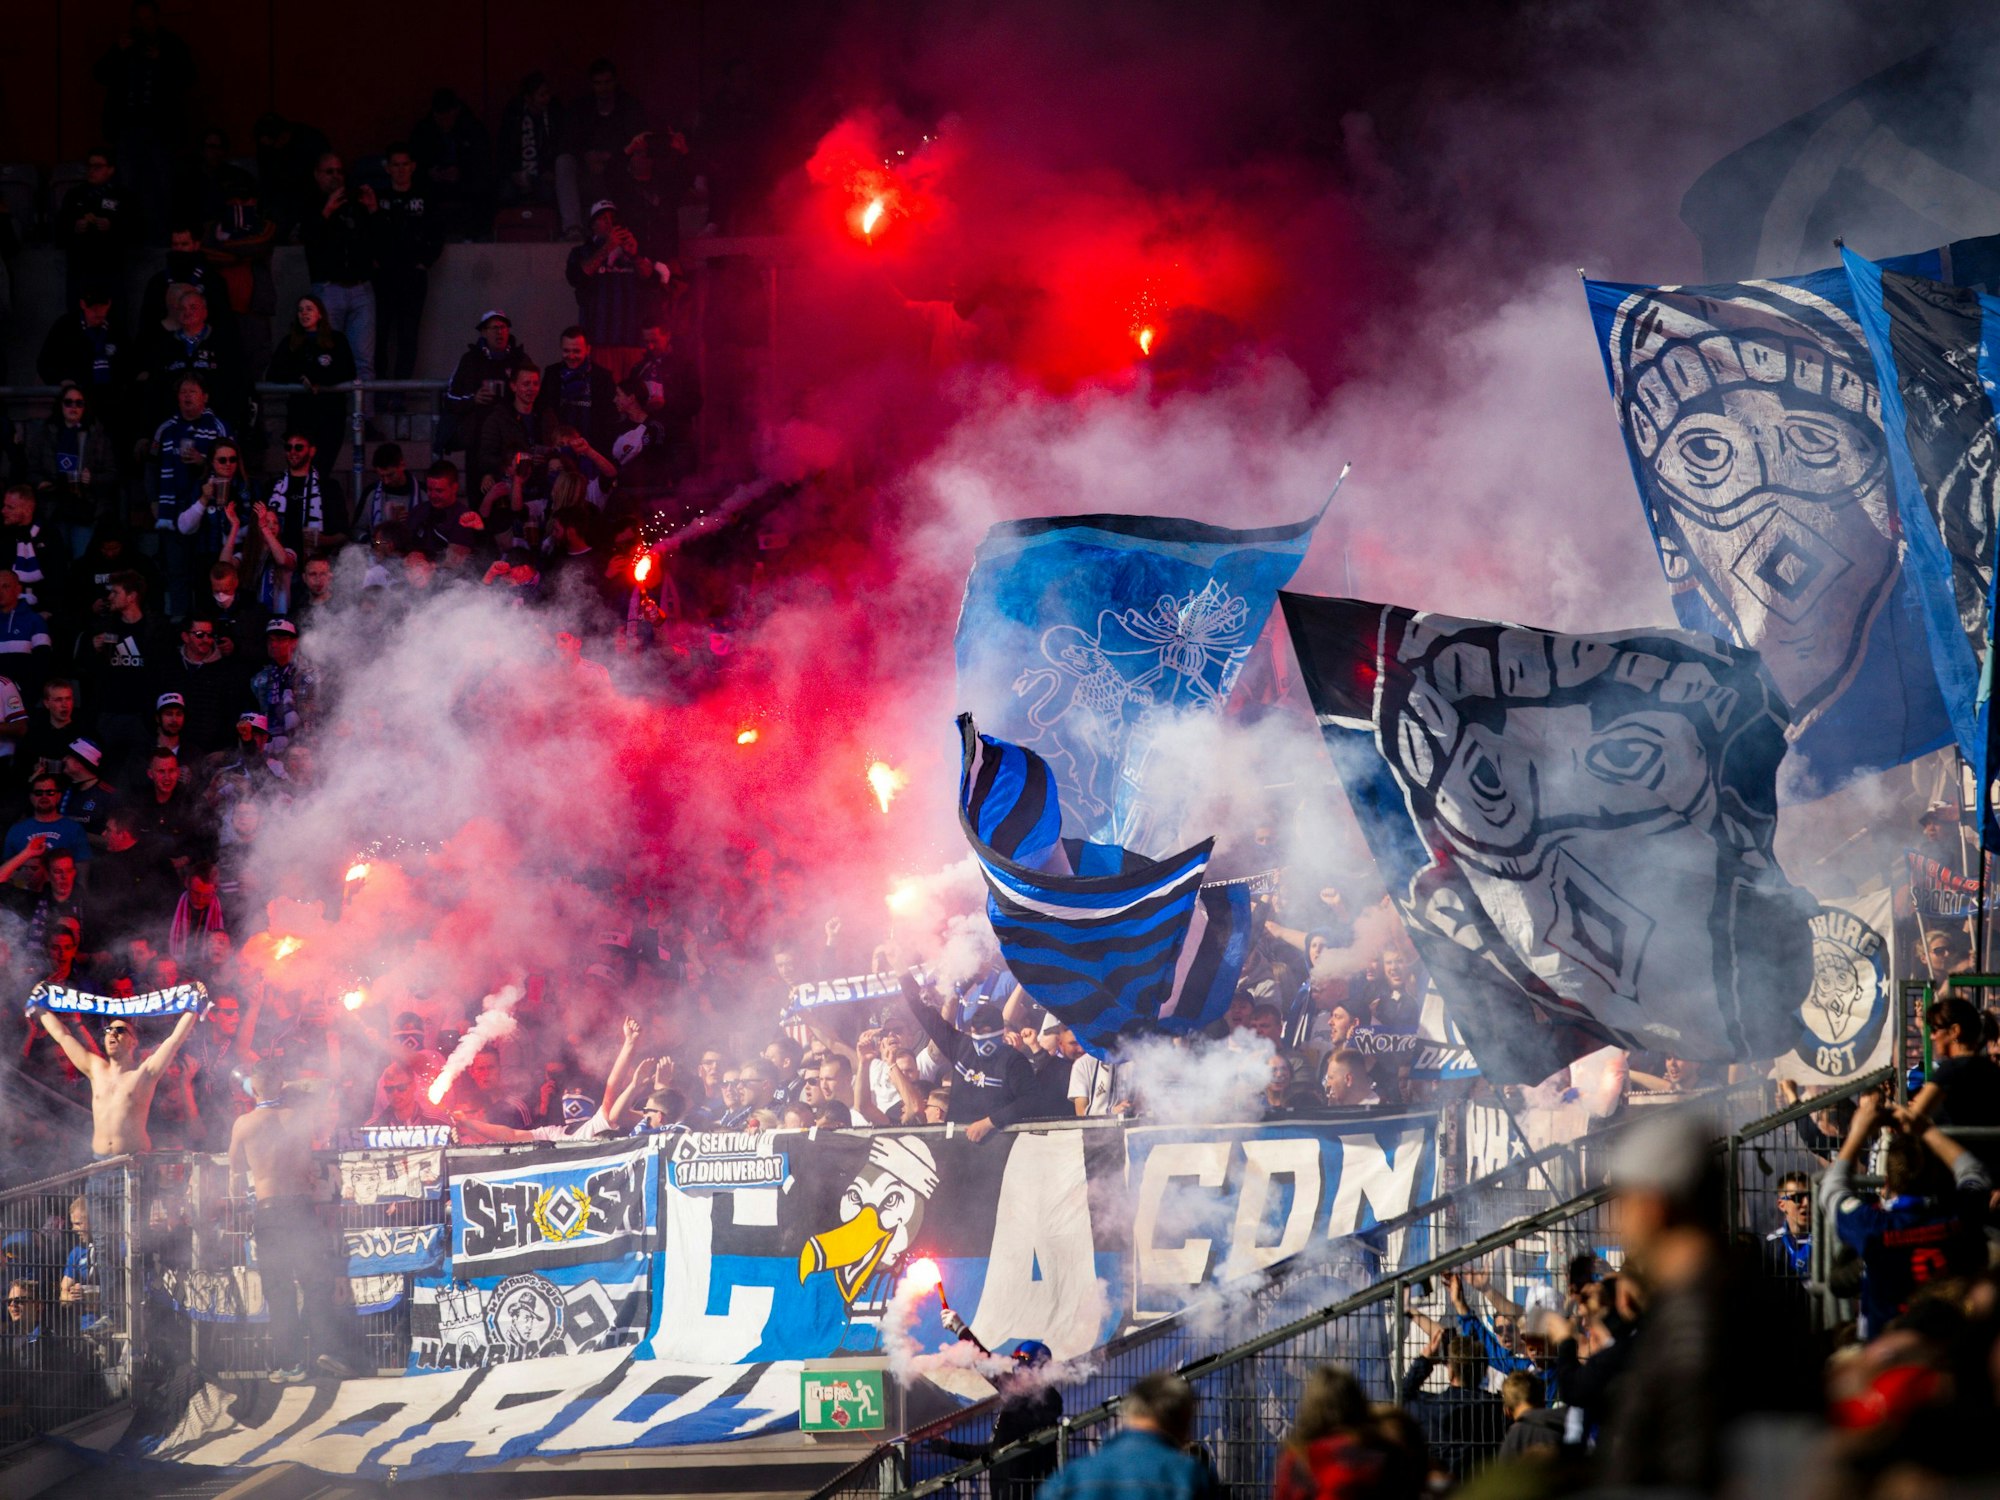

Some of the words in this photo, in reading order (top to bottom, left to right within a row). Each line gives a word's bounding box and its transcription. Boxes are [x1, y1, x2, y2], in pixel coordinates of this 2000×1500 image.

[111, 654, 145, 667] adidas
[1911, 887, 1964, 915] SPORT
[1808, 911, 1881, 956] BURG
[47, 984, 195, 1015] CASTAWAYS
[1816, 1041, 1857, 1075] OST
[701, 1132, 758, 1154] SEKTION
[677, 1157, 782, 1184] STADIONVERBOT
[463, 1175, 545, 1257] SEK
[1133, 1127, 1426, 1285] CDN
[488, 1273, 537, 1313] HAMBURG
[538, 1281, 564, 1308] SÜD
